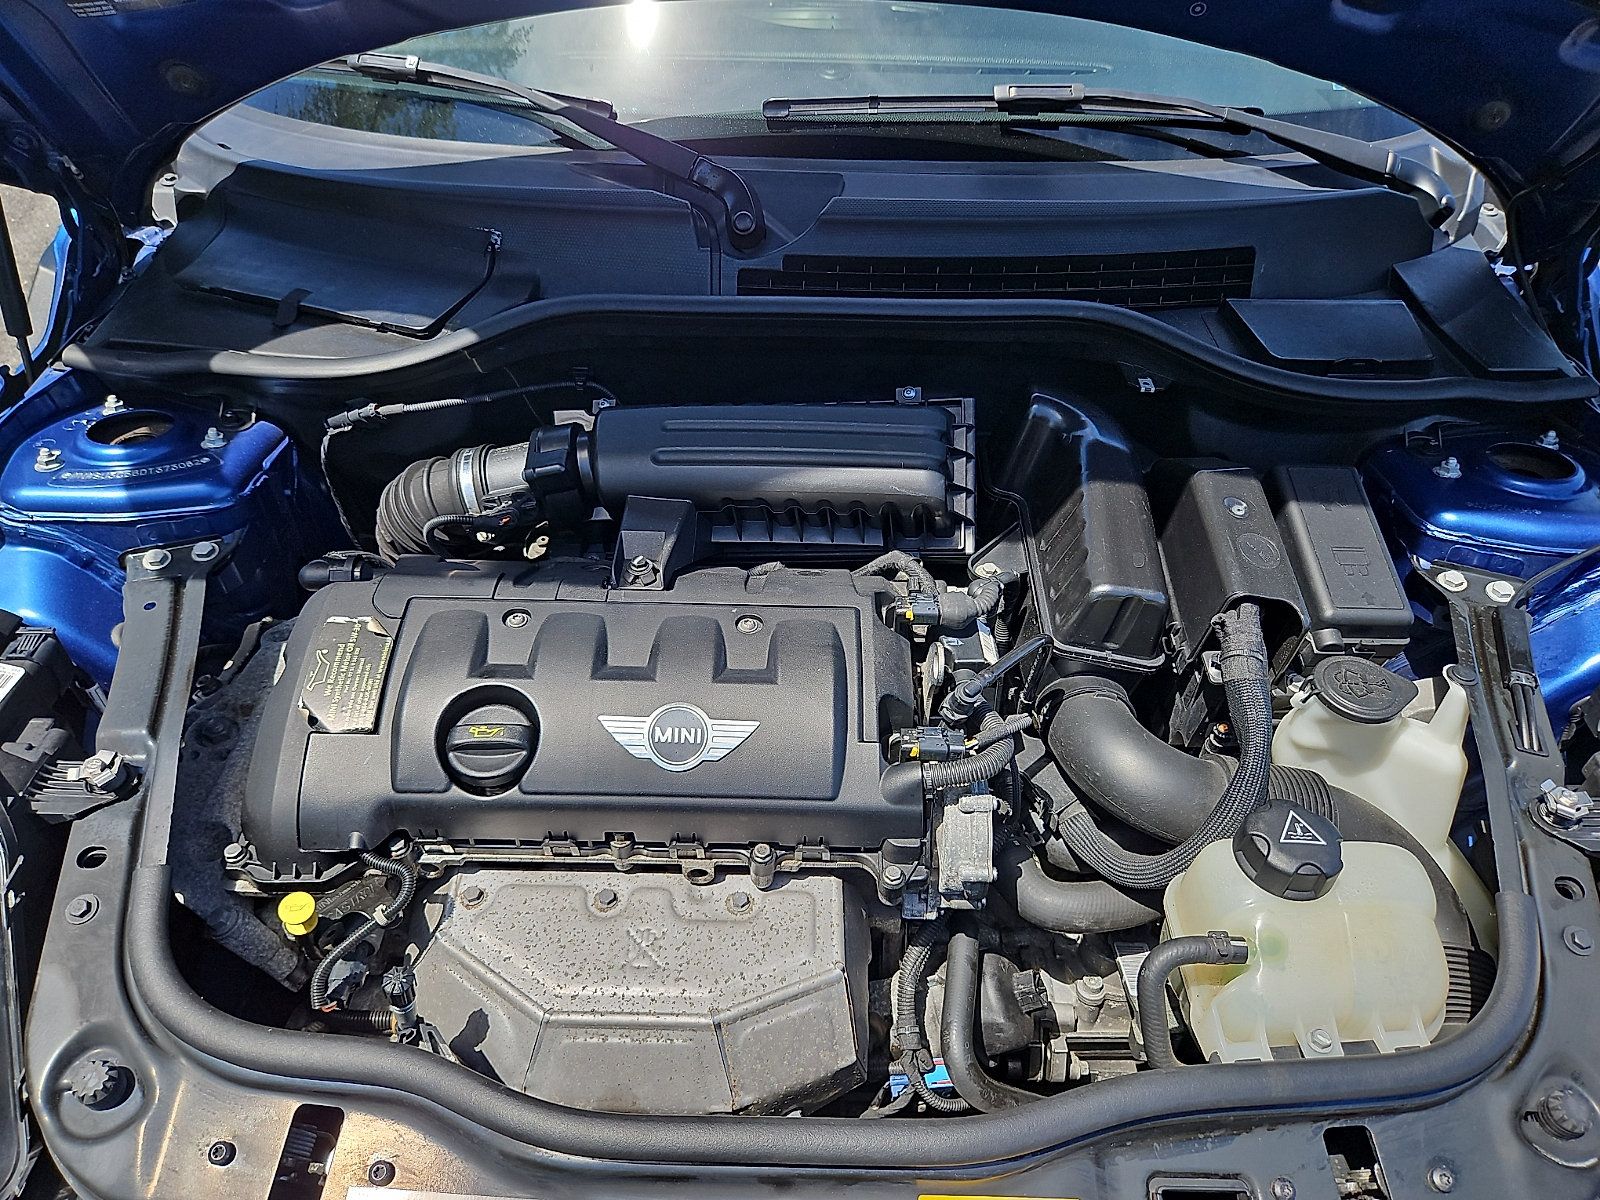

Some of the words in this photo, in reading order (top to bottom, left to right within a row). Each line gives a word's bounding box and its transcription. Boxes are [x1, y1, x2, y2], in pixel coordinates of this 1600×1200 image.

[347, 642, 355, 652] Oil
[326, 641, 345, 684] Recommend
[341, 652, 352, 672] Motor
[323, 683, 333, 697] We
[331, 671, 348, 703] Synthetic
[325, 702, 339, 721] MINI
[654, 726, 702, 744] MINI
